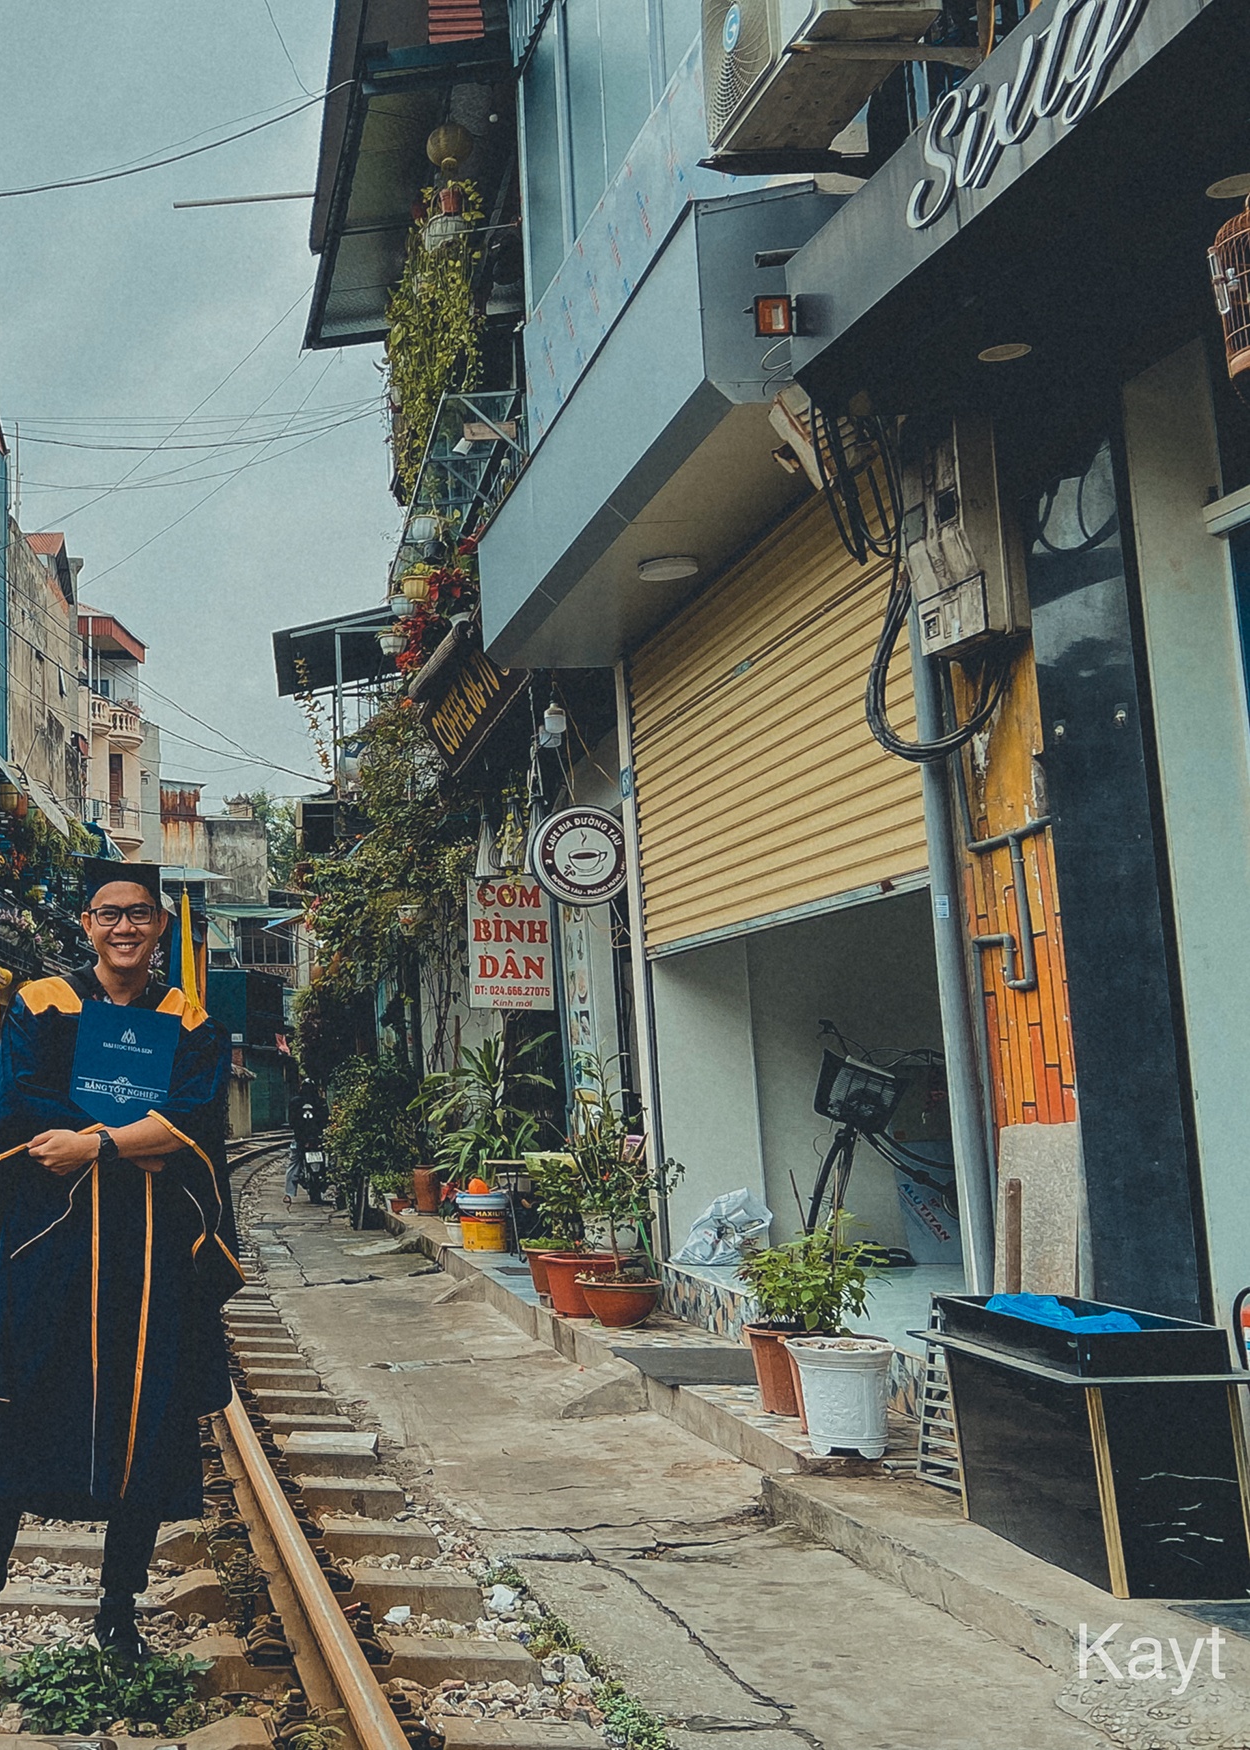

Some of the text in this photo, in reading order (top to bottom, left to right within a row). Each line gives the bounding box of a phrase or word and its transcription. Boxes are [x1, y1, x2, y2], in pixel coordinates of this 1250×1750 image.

[431, 684, 477, 755] COFFEE
[546, 830, 561, 851] CAFE
[558, 821, 573, 832] BIA
[607, 829, 622, 846] TÀU
[473, 912, 548, 943] BÌNH
[478, 948, 545, 980] DÂN
[490, 986, 550, 996] 024.666.27075
